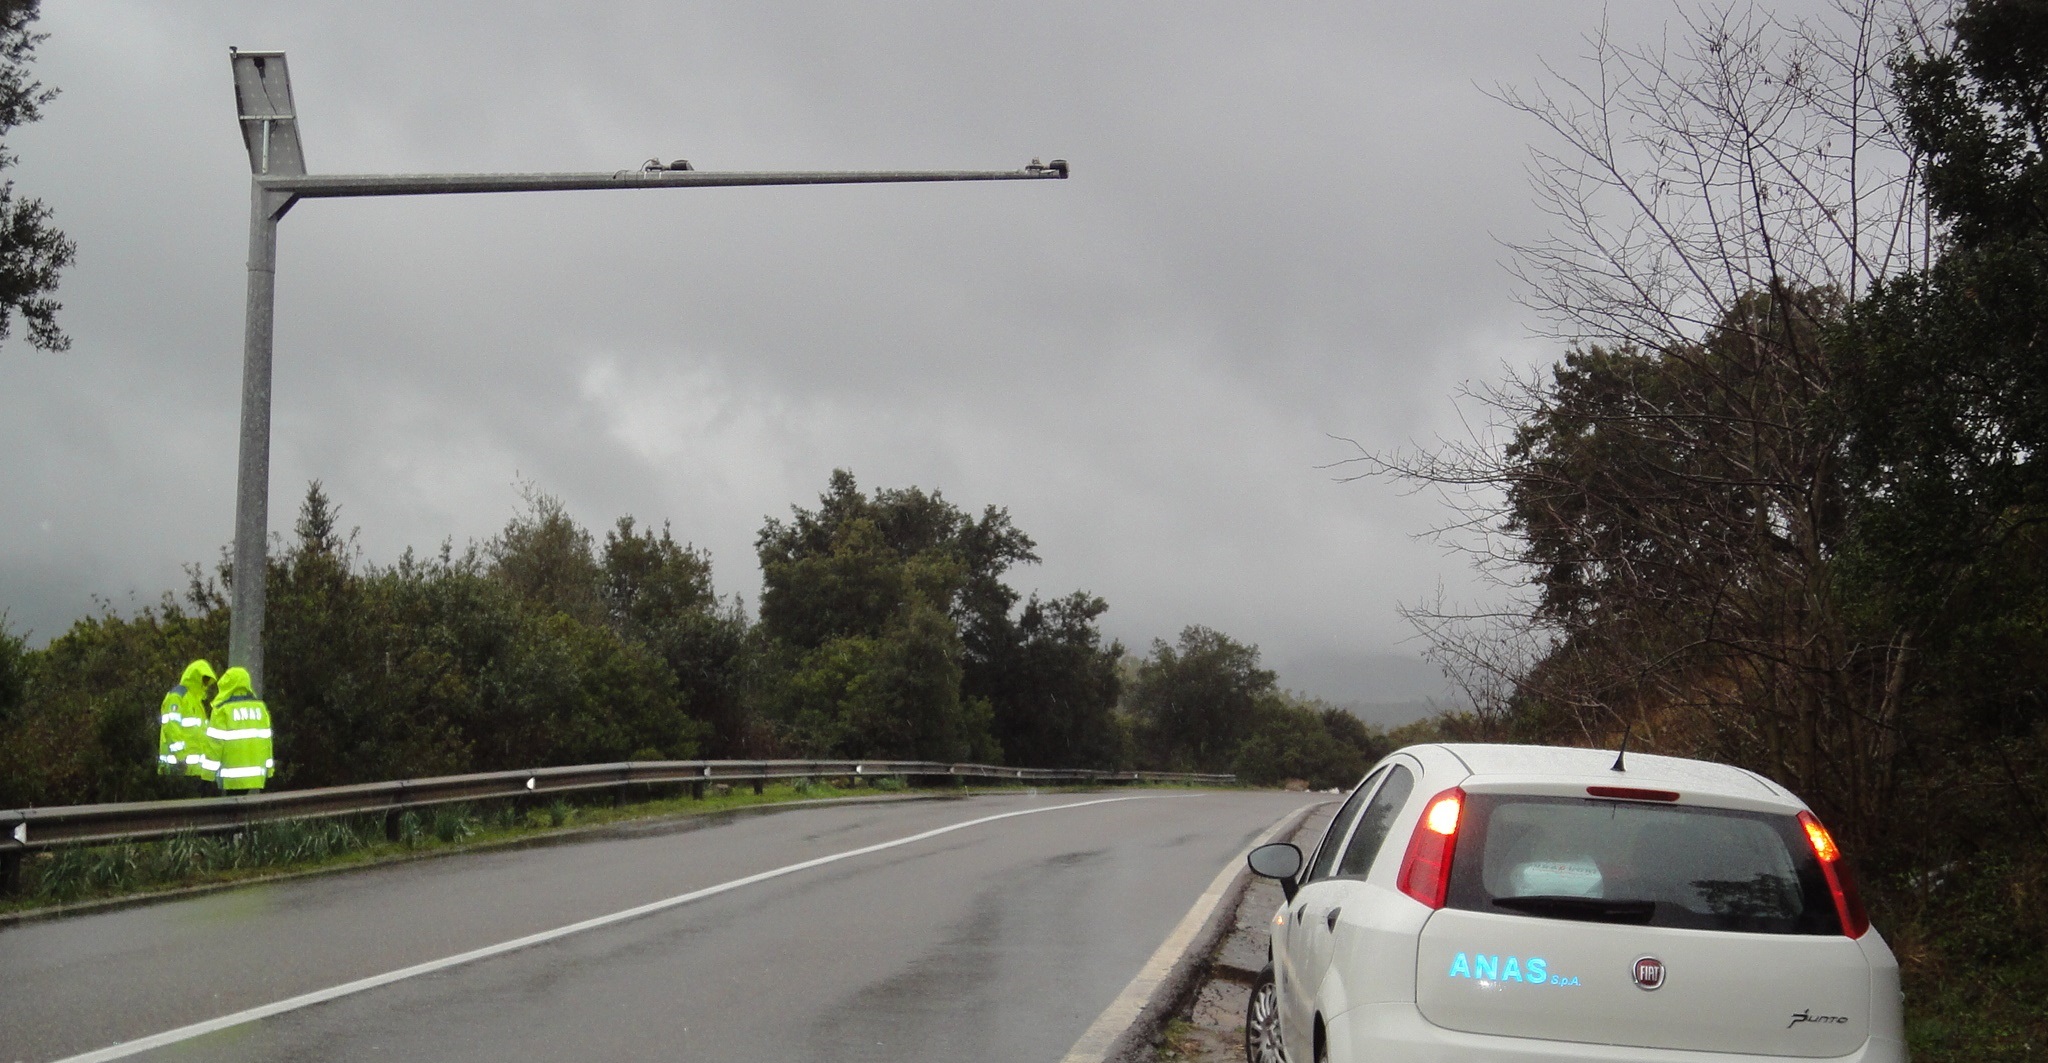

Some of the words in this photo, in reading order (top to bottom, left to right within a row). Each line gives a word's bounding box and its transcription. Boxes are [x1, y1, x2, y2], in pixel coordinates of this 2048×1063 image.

[233, 707, 262, 721] ANAS
[1449, 951, 1548, 984] ANAS
[1550, 974, 1582, 987] S.p.A.
[1640, 965, 1660, 981] FIAT
